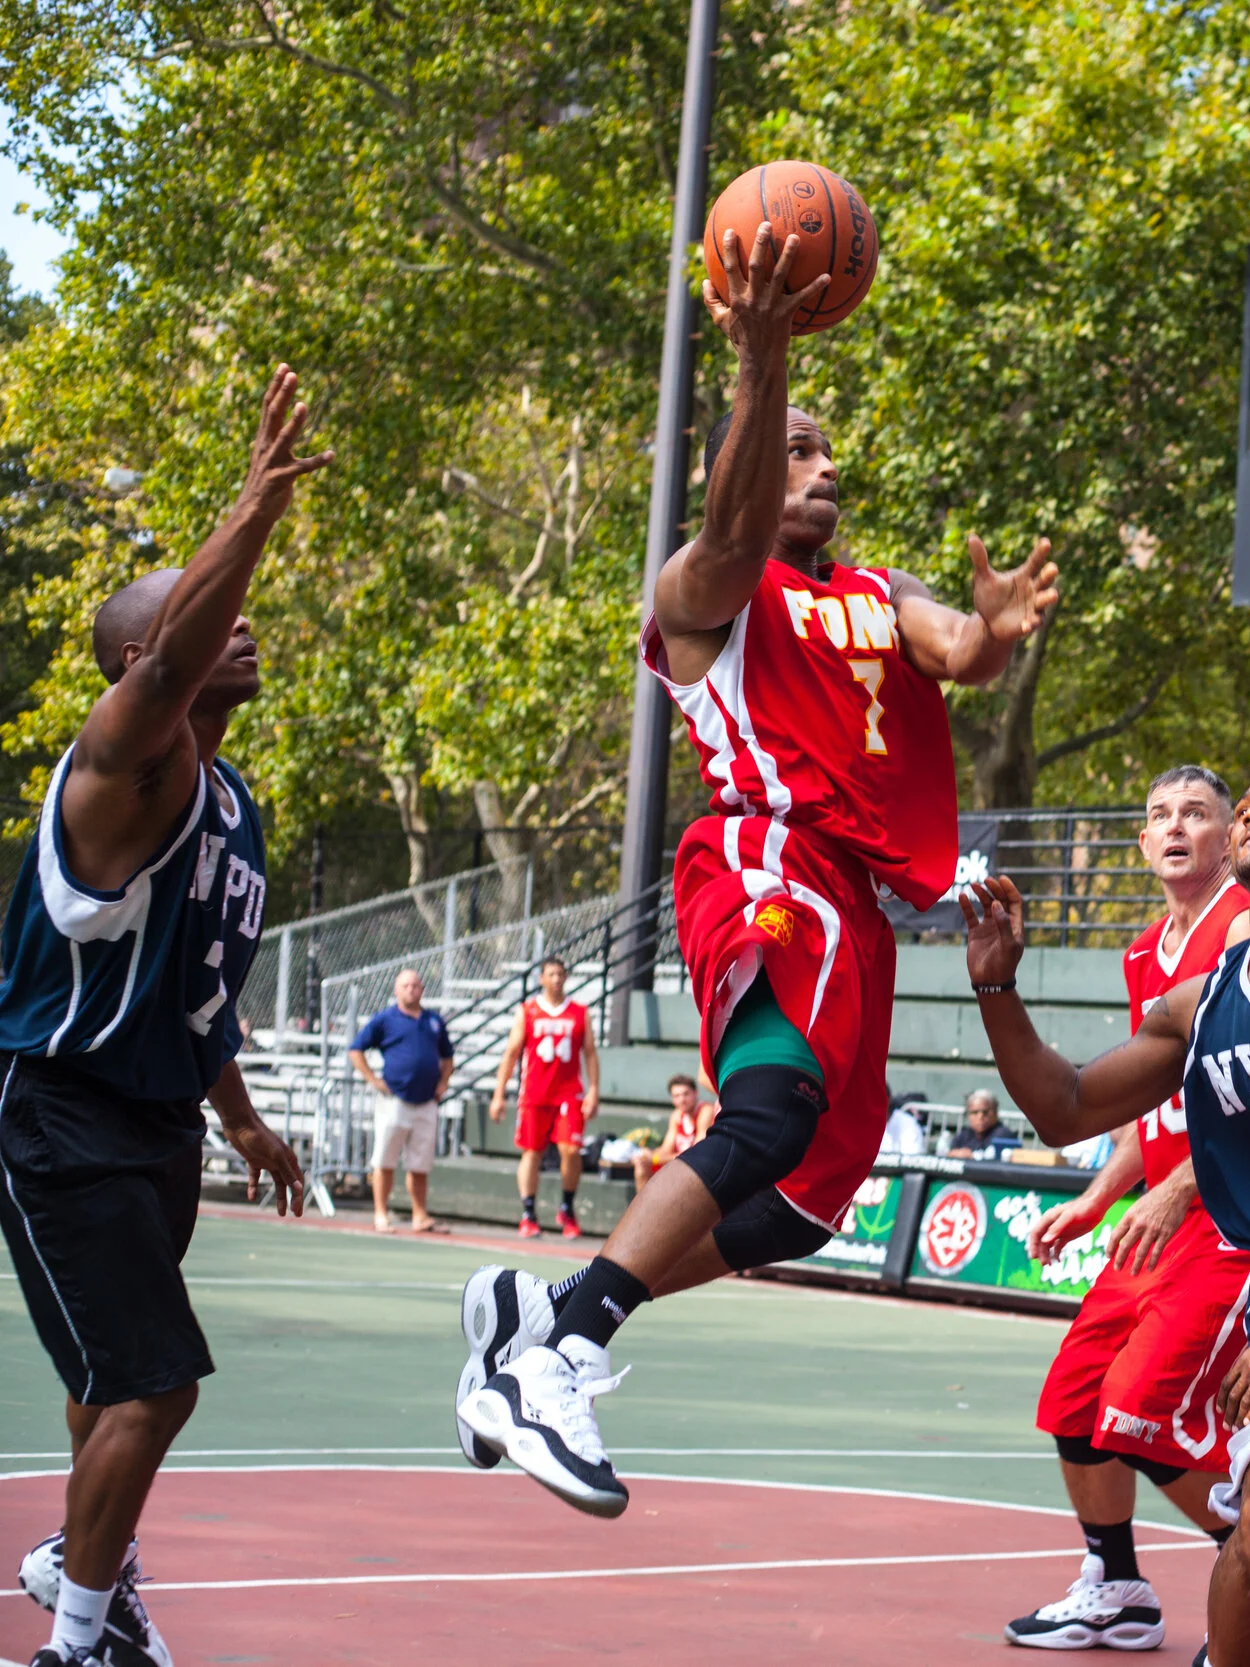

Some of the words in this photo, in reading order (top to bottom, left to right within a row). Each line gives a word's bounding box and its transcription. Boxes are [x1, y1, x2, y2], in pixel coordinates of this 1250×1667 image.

[846, 658, 888, 755] 7
[536, 1034, 572, 1063] 44
[1101, 1405, 1161, 1444] FDNY
